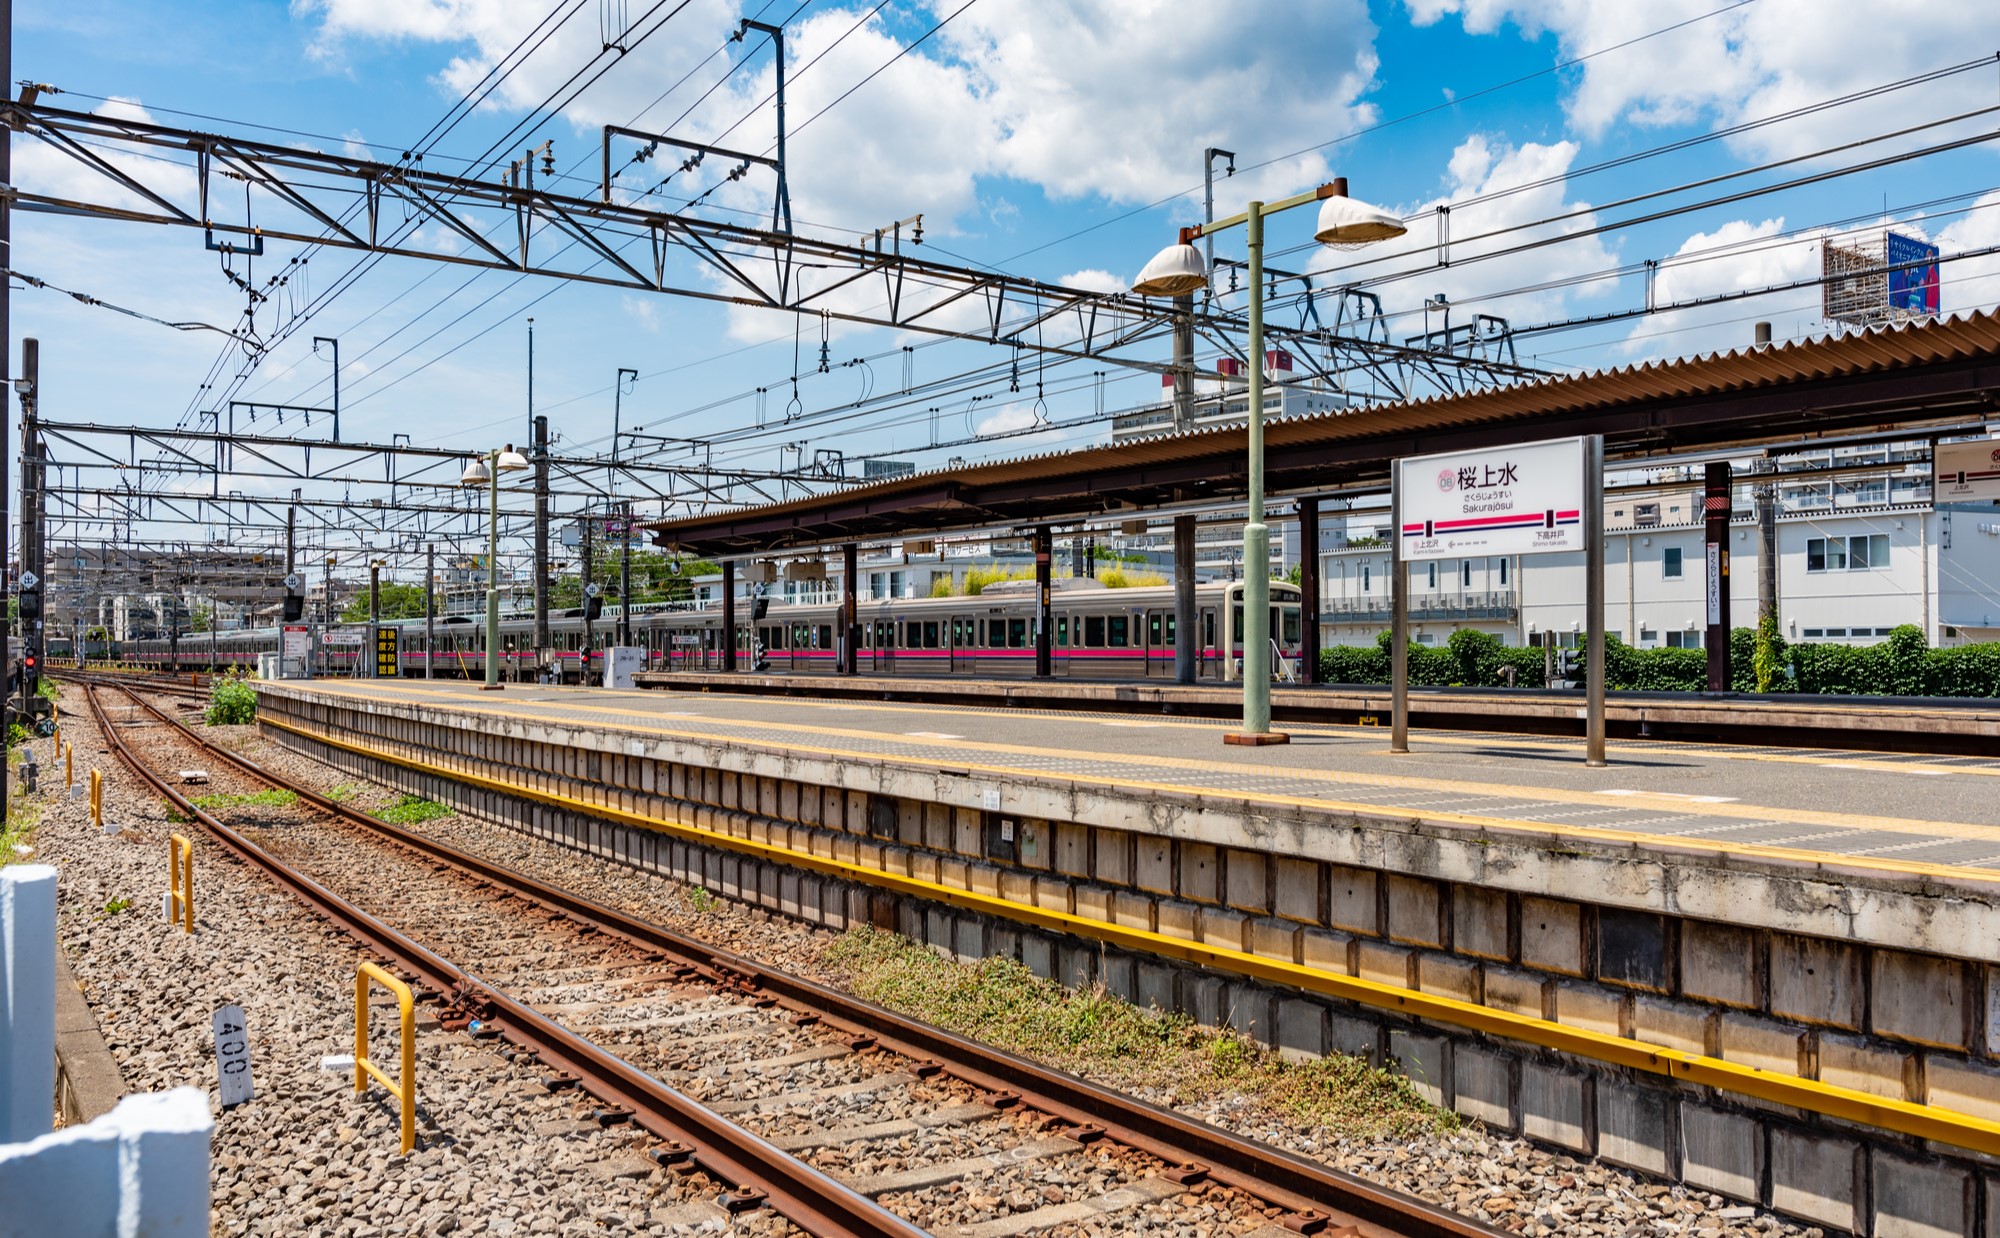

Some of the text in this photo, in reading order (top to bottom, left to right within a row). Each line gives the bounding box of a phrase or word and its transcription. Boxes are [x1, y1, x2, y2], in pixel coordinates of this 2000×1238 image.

[1458, 462, 1518, 490] 桜上水
[1440, 477, 1453, 488] 08
[1464, 490, 1512, 502] さくらじょうすい
[1463, 500, 1513, 514] Sakurajōsui
[24, 575, 33, 584] 出
[45, 722, 55, 732] 10
[219, 1023, 248, 1075] 400
